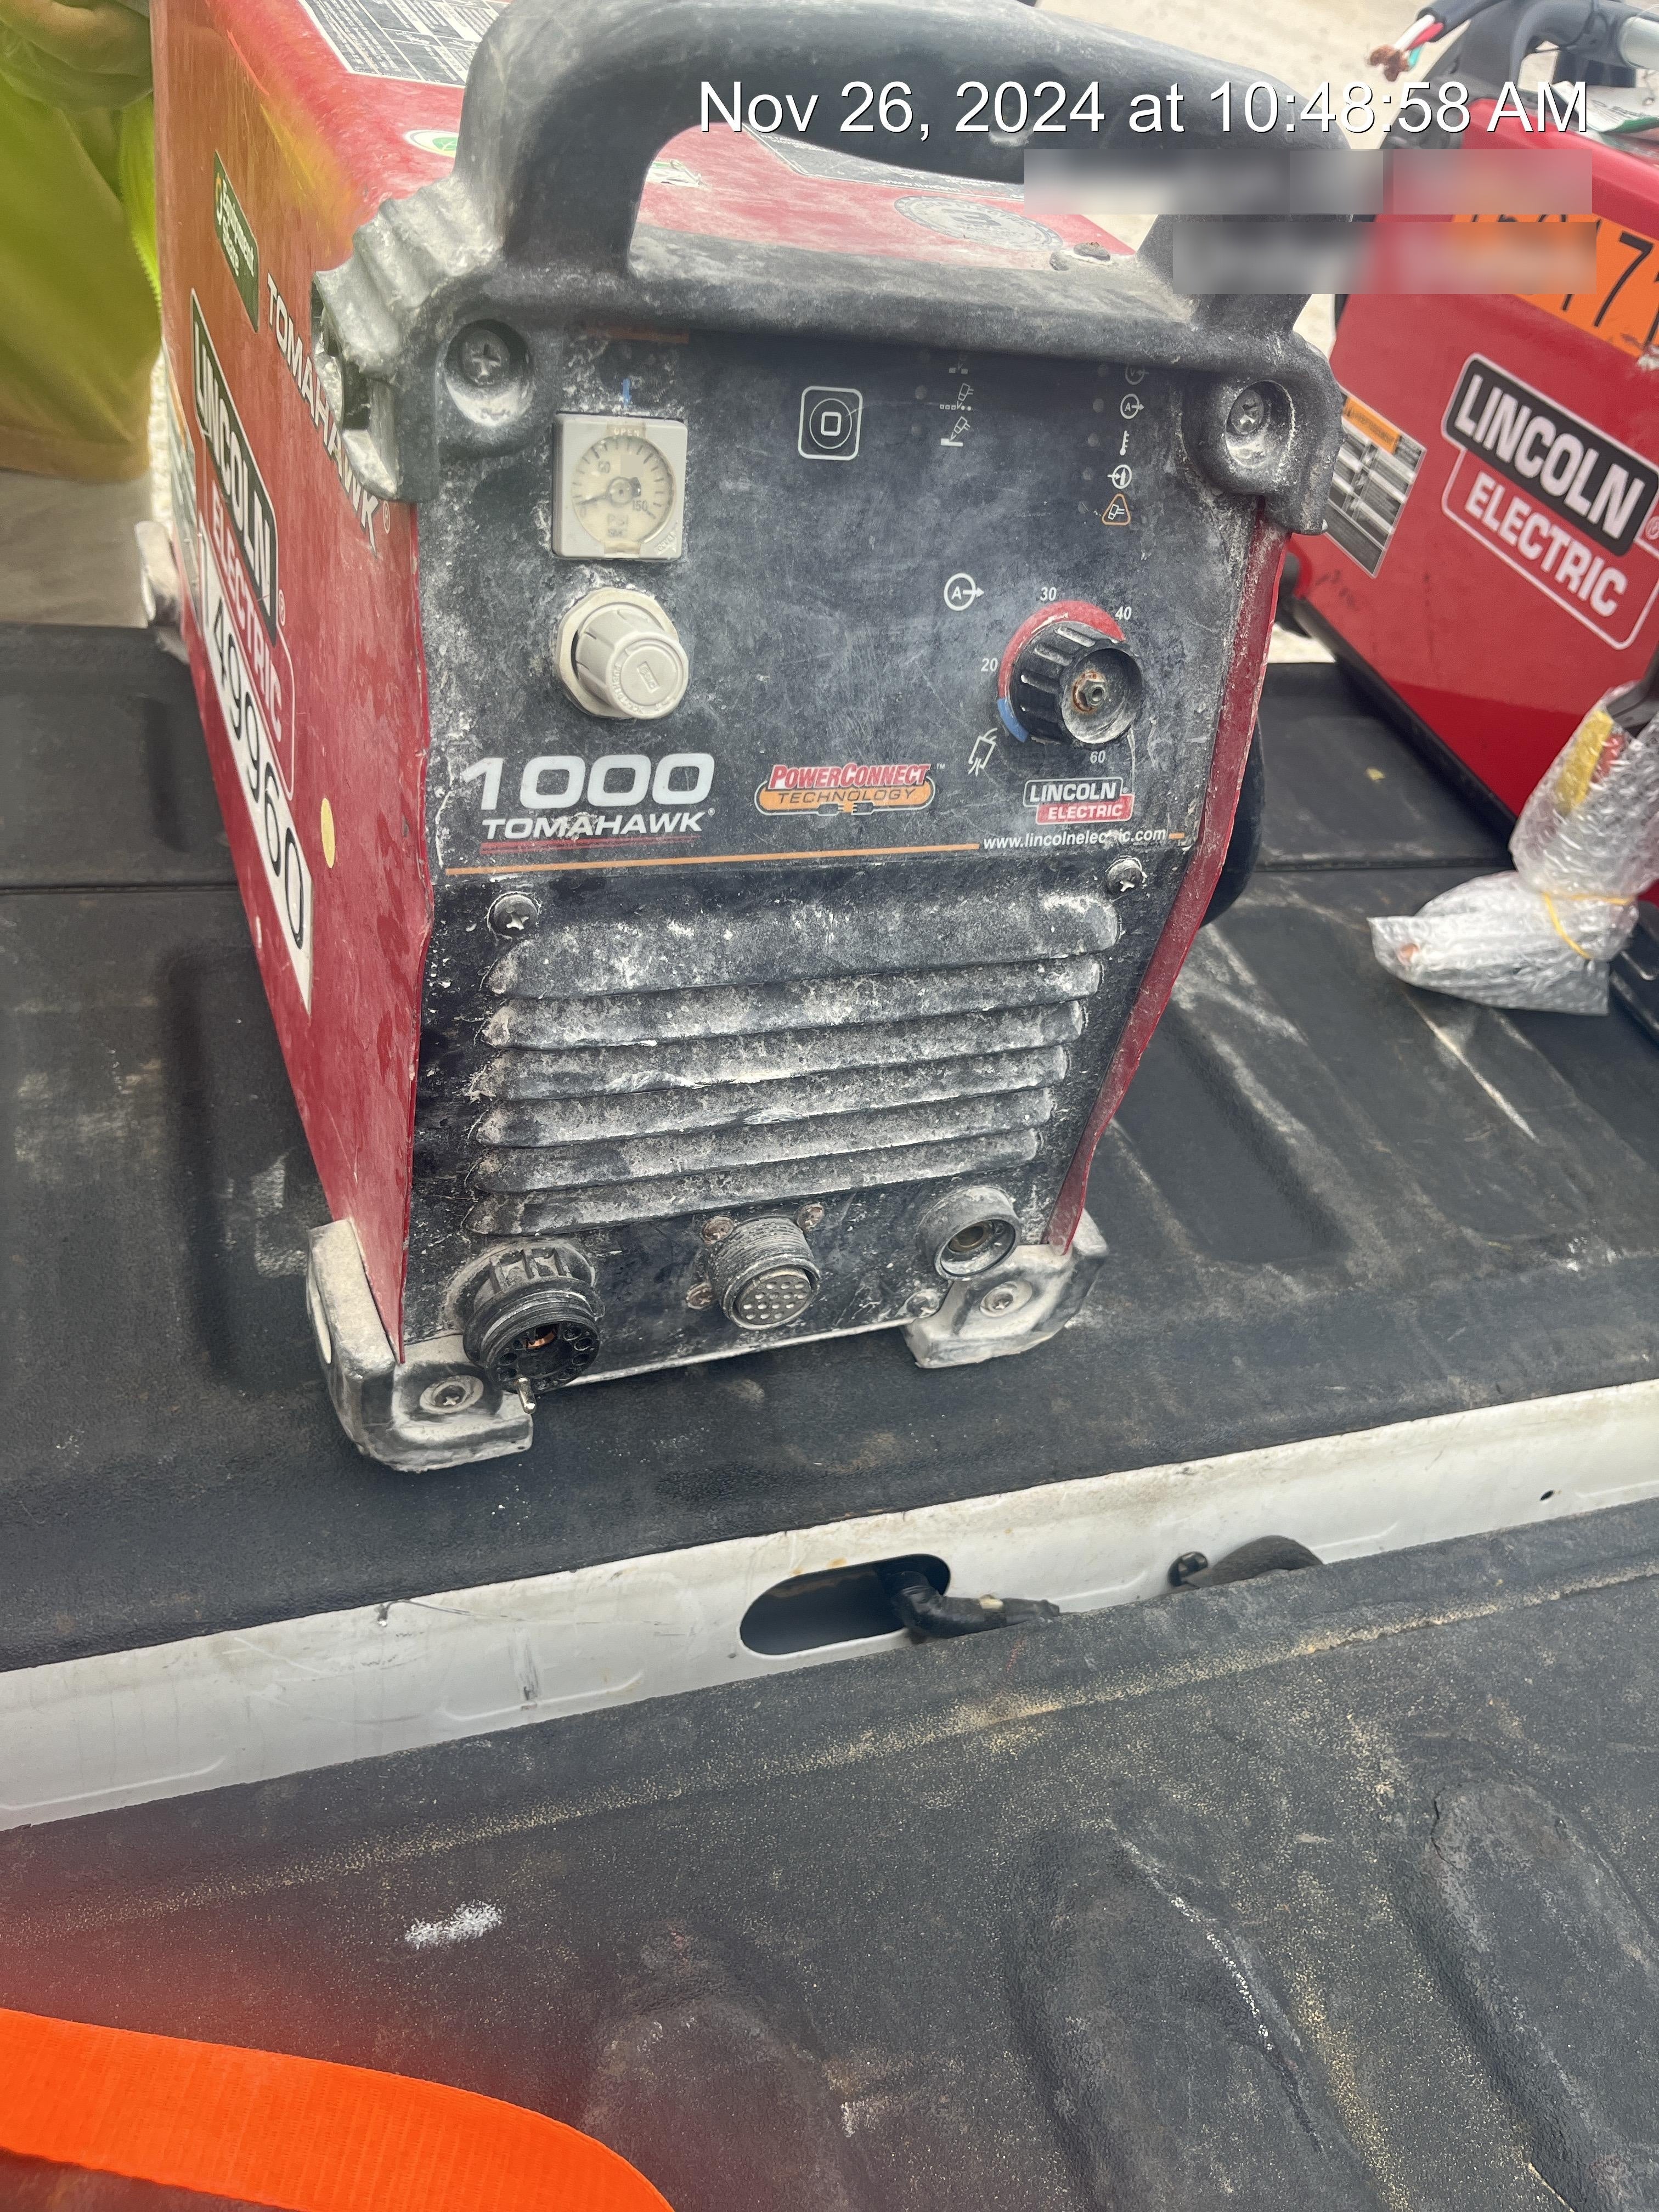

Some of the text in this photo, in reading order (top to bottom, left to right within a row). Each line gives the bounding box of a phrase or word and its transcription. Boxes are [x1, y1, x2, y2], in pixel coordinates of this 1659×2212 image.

[613, 427, 641, 437] OPEN
[1454, 374, 1645, 540] LINCOLN
[194, 320, 271, 618] LINCOLN
[631, 500, 648, 512] 150
[1464, 470, 1628, 617] ELECTRIC
[1039, 587, 1057, 601] 30
[212, 479, 283, 743] ELECTRIC
[1114, 606, 1132, 620] 40
[980, 658, 998, 672] 20
[1090, 750, 1105, 764] 60
[462, 753, 715, 810] 1000
[778, 788, 916, 804] TECHNOLOGY
[1029, 782, 1117, 803] LINCOLN
[1047, 804, 1124, 820] ELECTRIC
[482, 811, 706, 840] TOMAHAWK
[983, 828, 1167, 849] www.lincolnelecic.com
